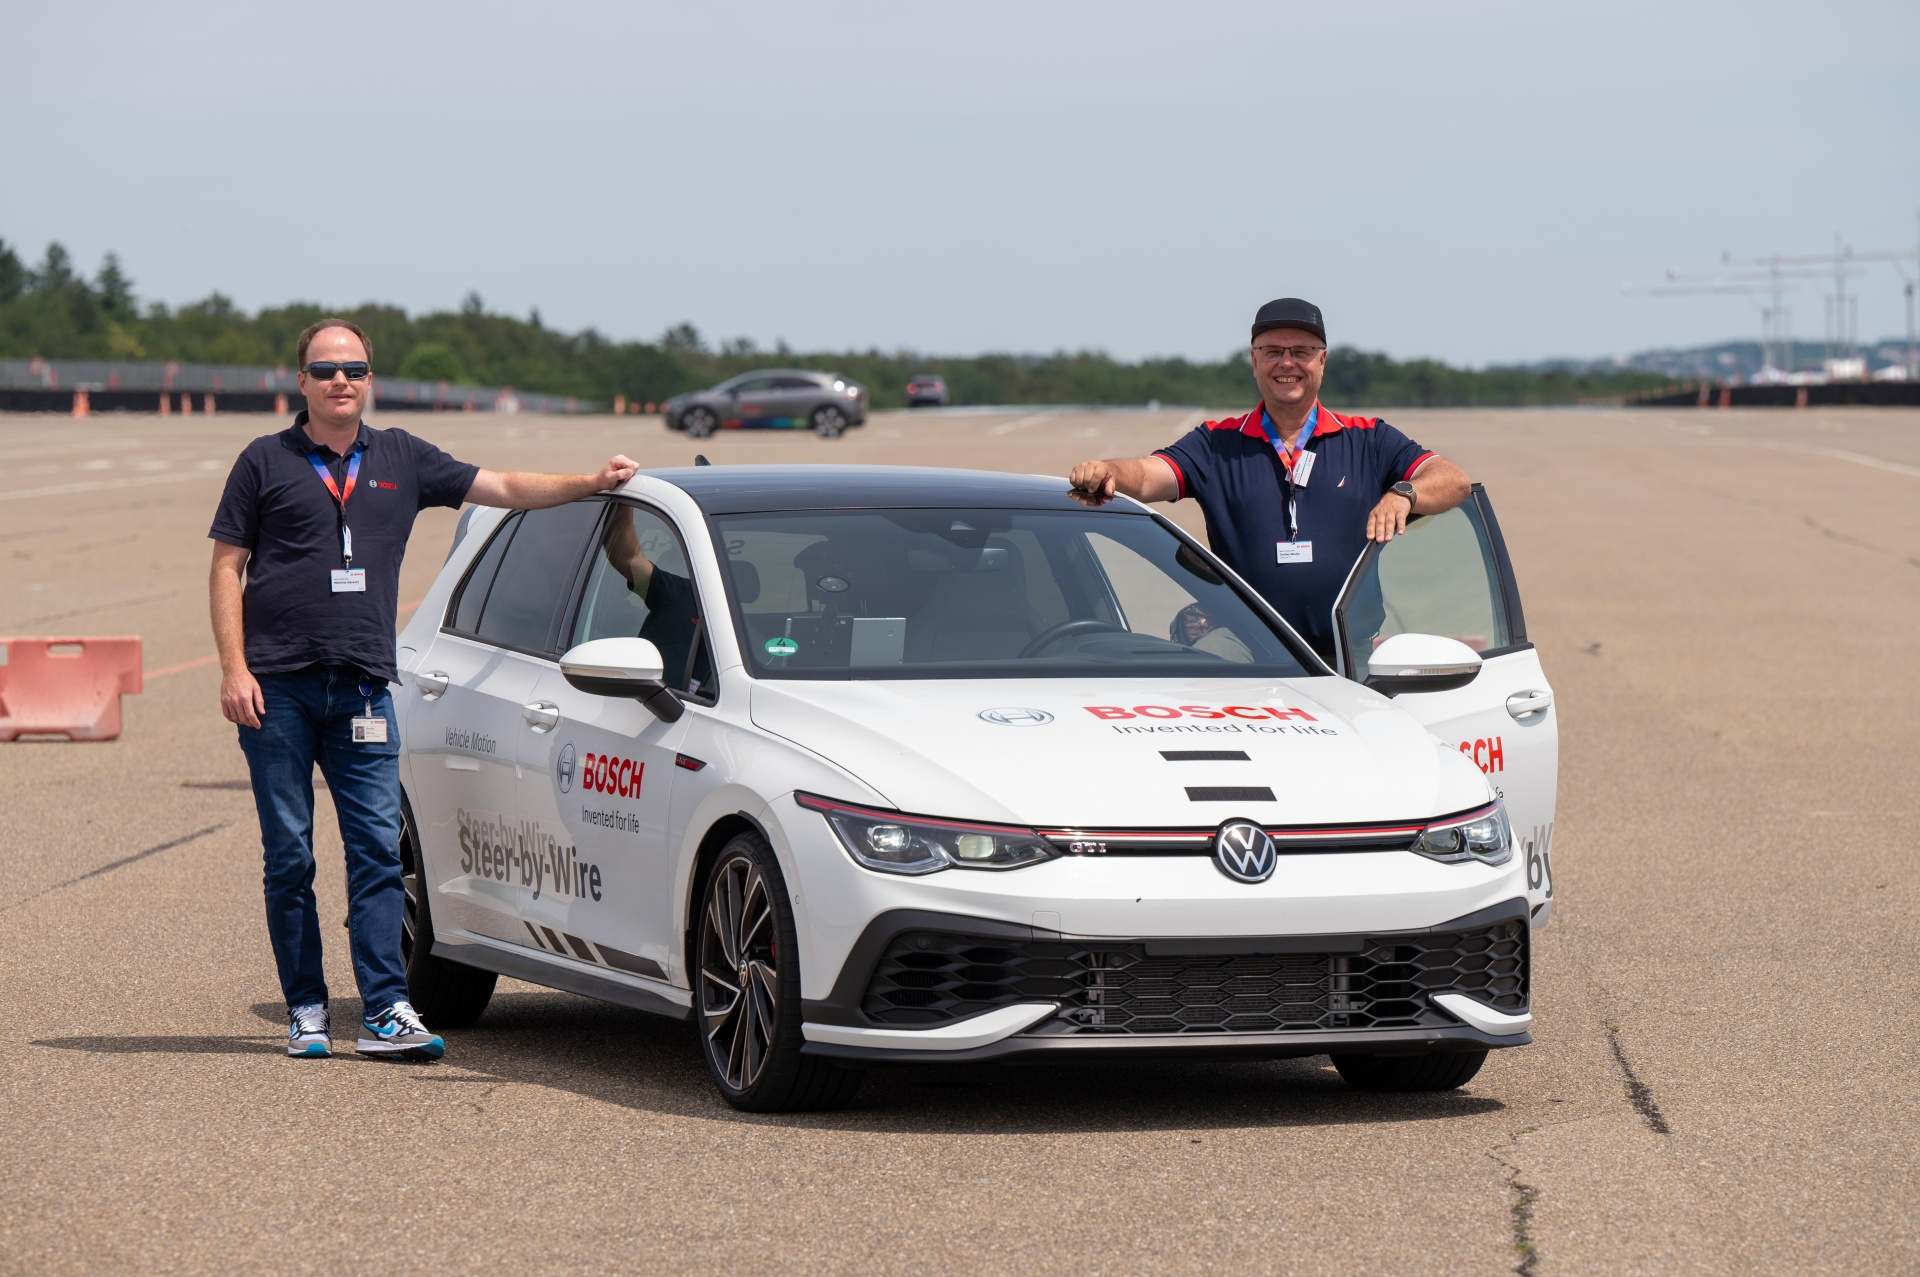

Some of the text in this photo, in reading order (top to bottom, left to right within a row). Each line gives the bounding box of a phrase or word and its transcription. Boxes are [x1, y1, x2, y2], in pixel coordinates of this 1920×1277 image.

[777, 638, 786, 648] 4
[1081, 705, 1319, 721] BOSCH
[445, 726, 497, 755] Vehicle Motion
[1111, 723, 1339, 737] Invented for life
[583, 752, 645, 800] BOSCH
[582, 804, 640, 834] Invented for life
[460, 825, 602, 902] Steer-by-Wire
